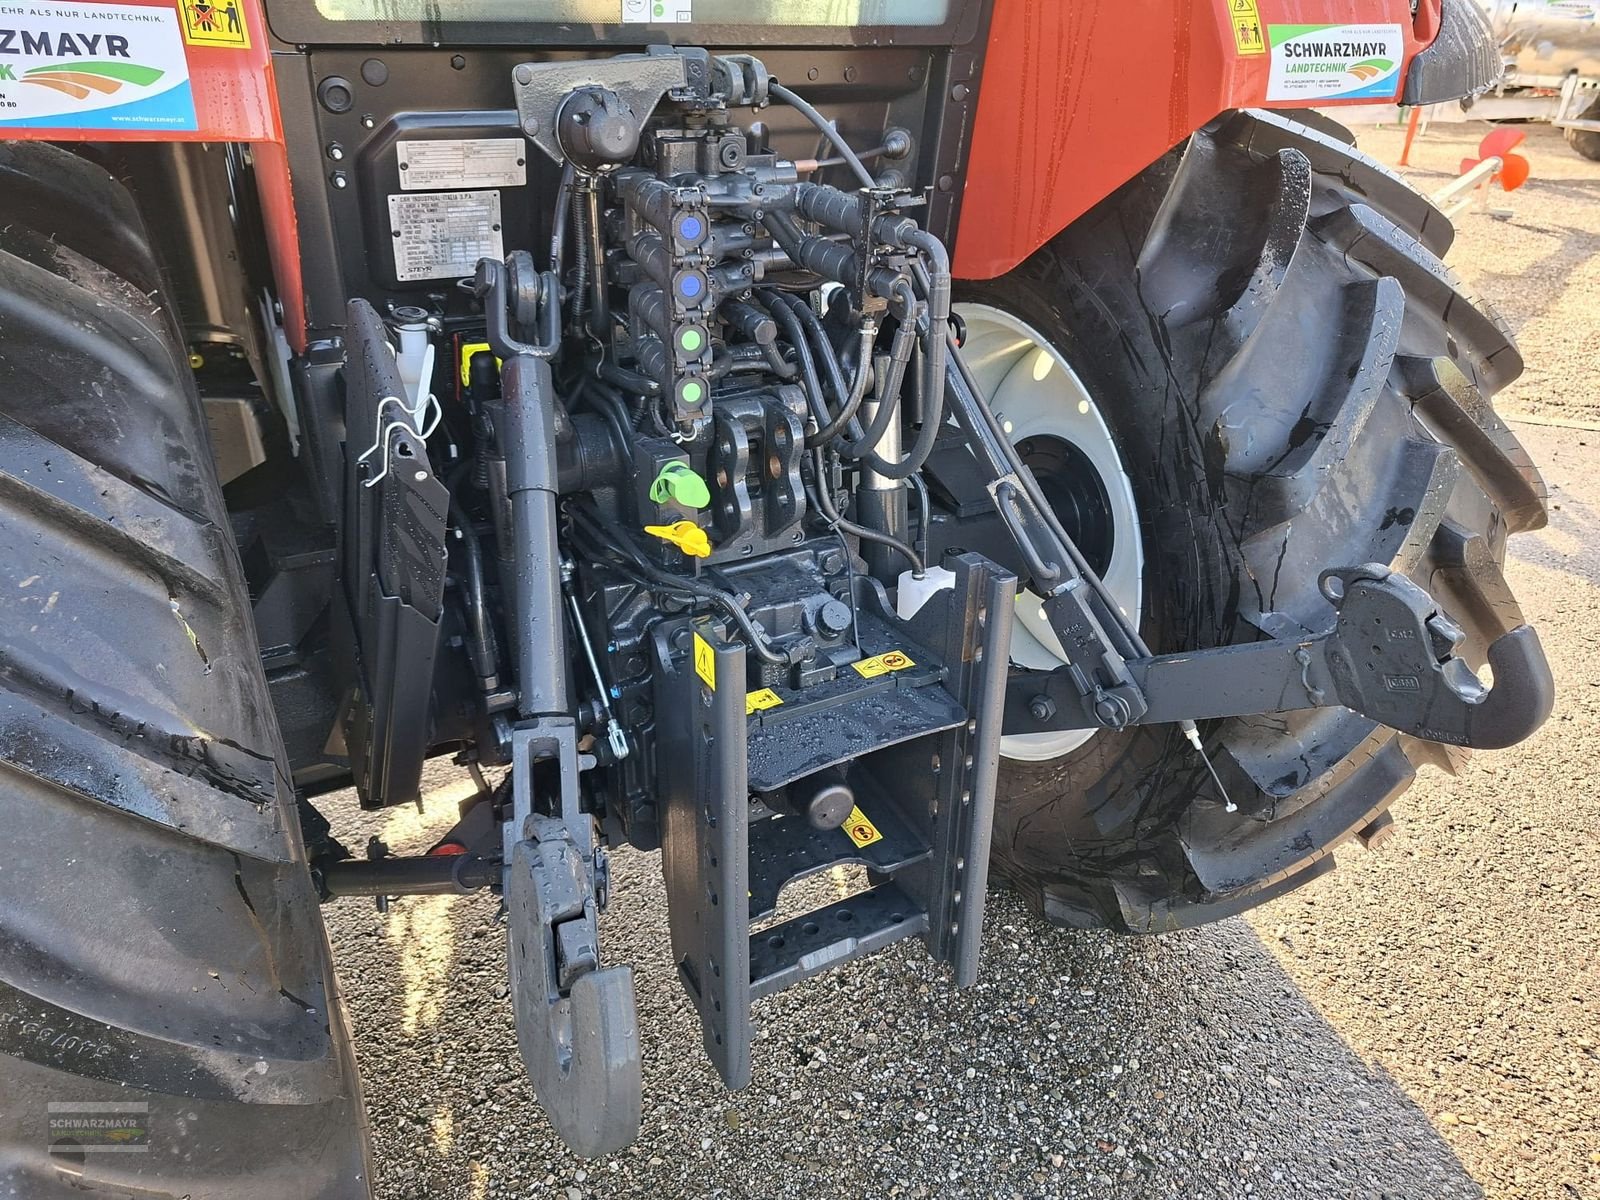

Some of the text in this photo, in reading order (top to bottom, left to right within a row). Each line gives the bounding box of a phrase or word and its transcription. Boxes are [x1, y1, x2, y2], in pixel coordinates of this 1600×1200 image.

[83, 12, 165, 23] LANDTECHNIK.
[1284, 43, 1387, 58] SCHWARZMAYR
[1285, 62, 1347, 74] LANDTECHNIK
[111, 115, 185, 124] www.schwarzmayr.at
